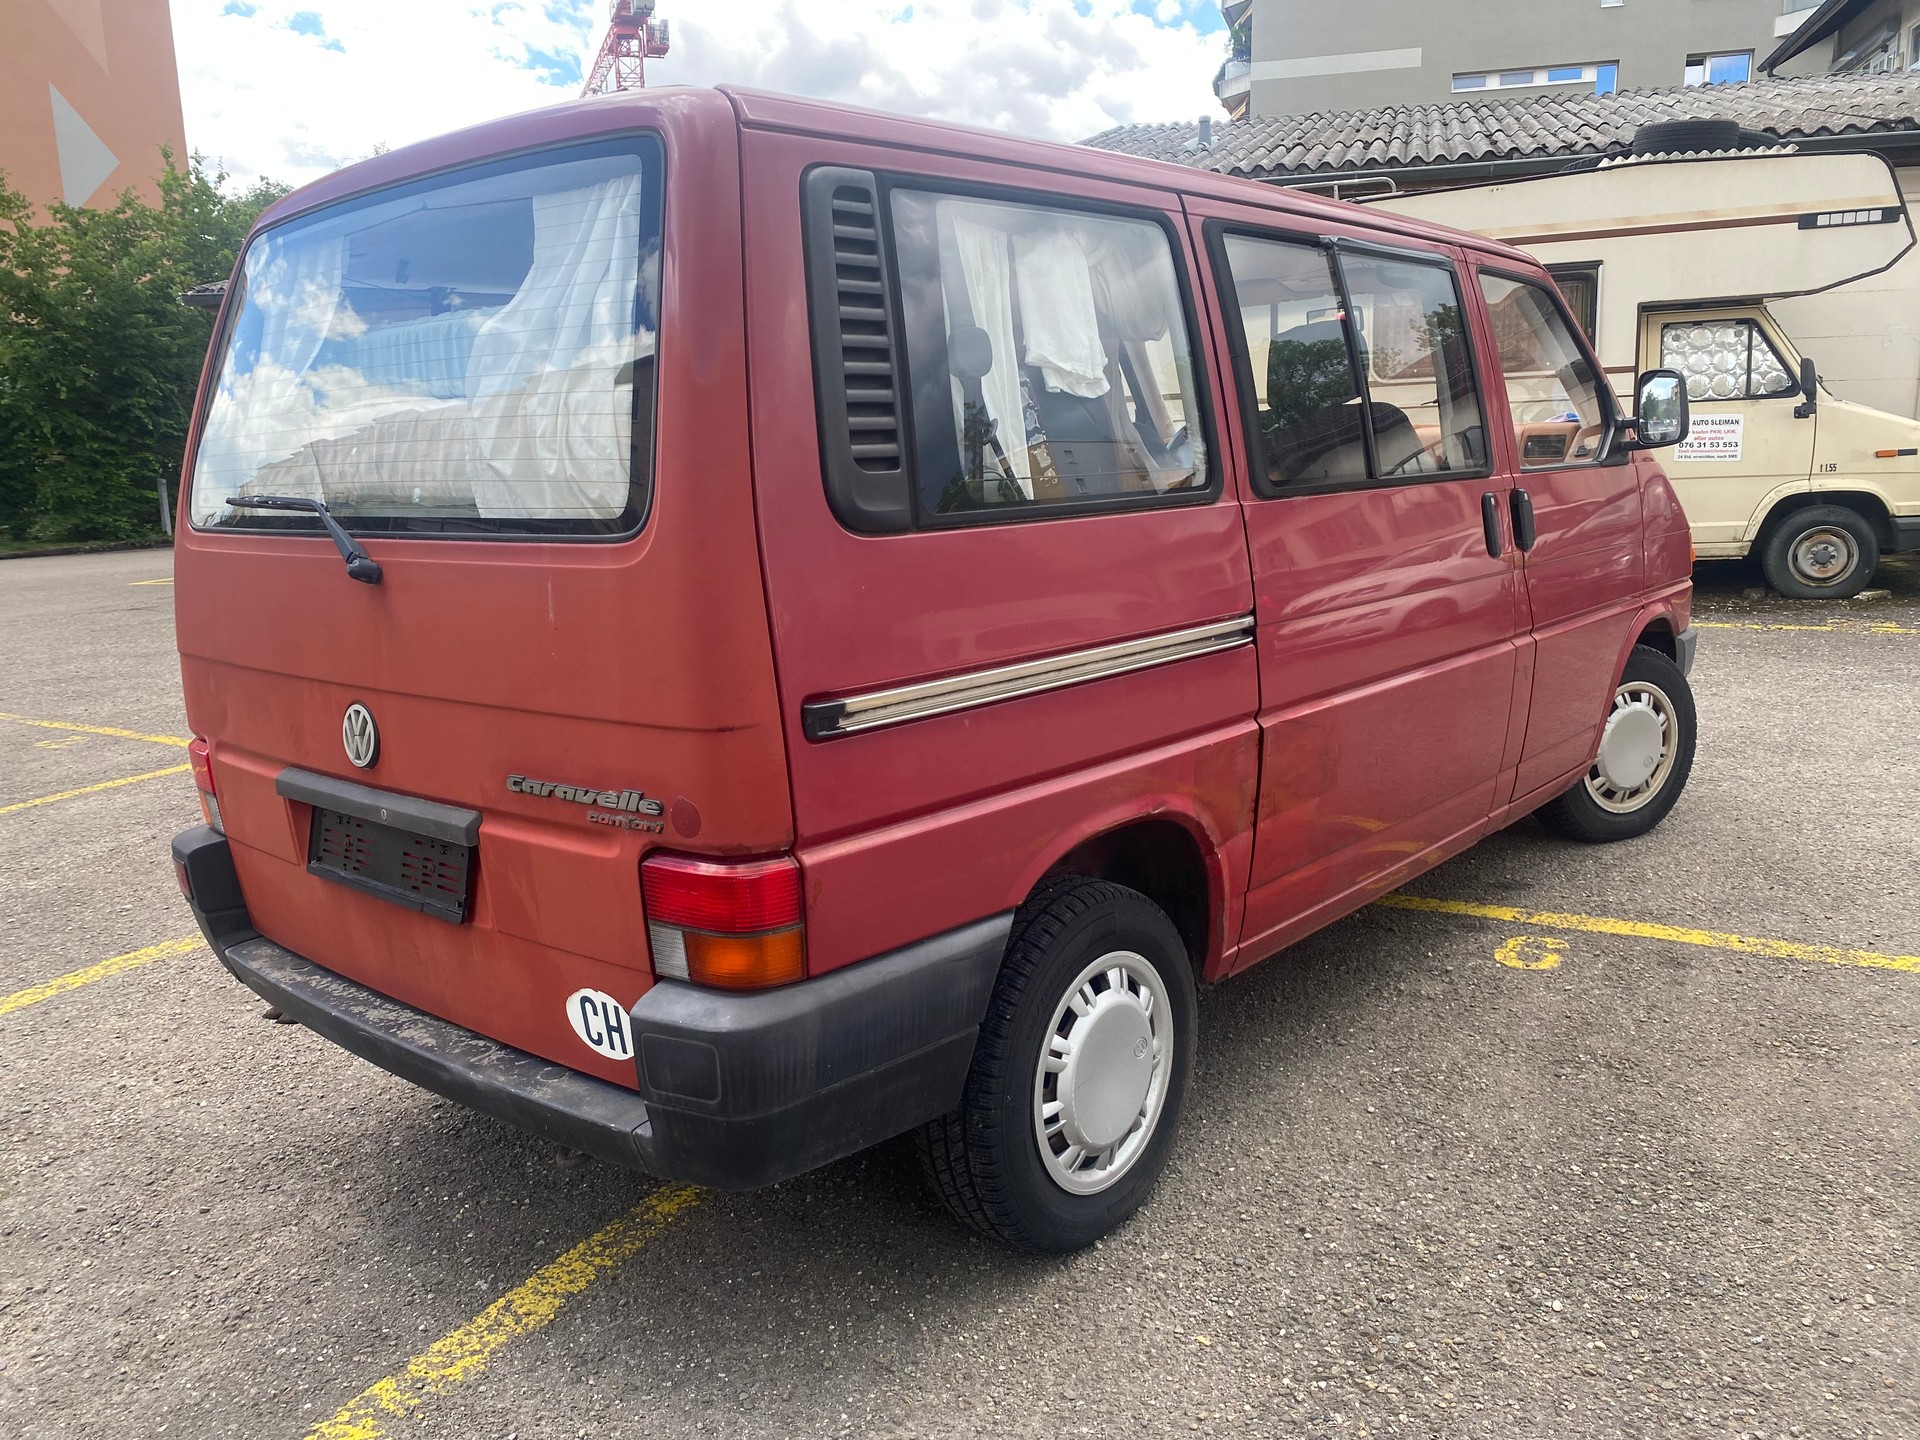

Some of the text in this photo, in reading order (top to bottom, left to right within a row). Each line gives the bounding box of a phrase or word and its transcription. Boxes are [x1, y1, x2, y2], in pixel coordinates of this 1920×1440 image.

[342, 703, 375, 768] VW
[506, 774, 664, 816] Caravelle
[586, 811, 665, 835] comfort
[579, 995, 628, 1055] CH
